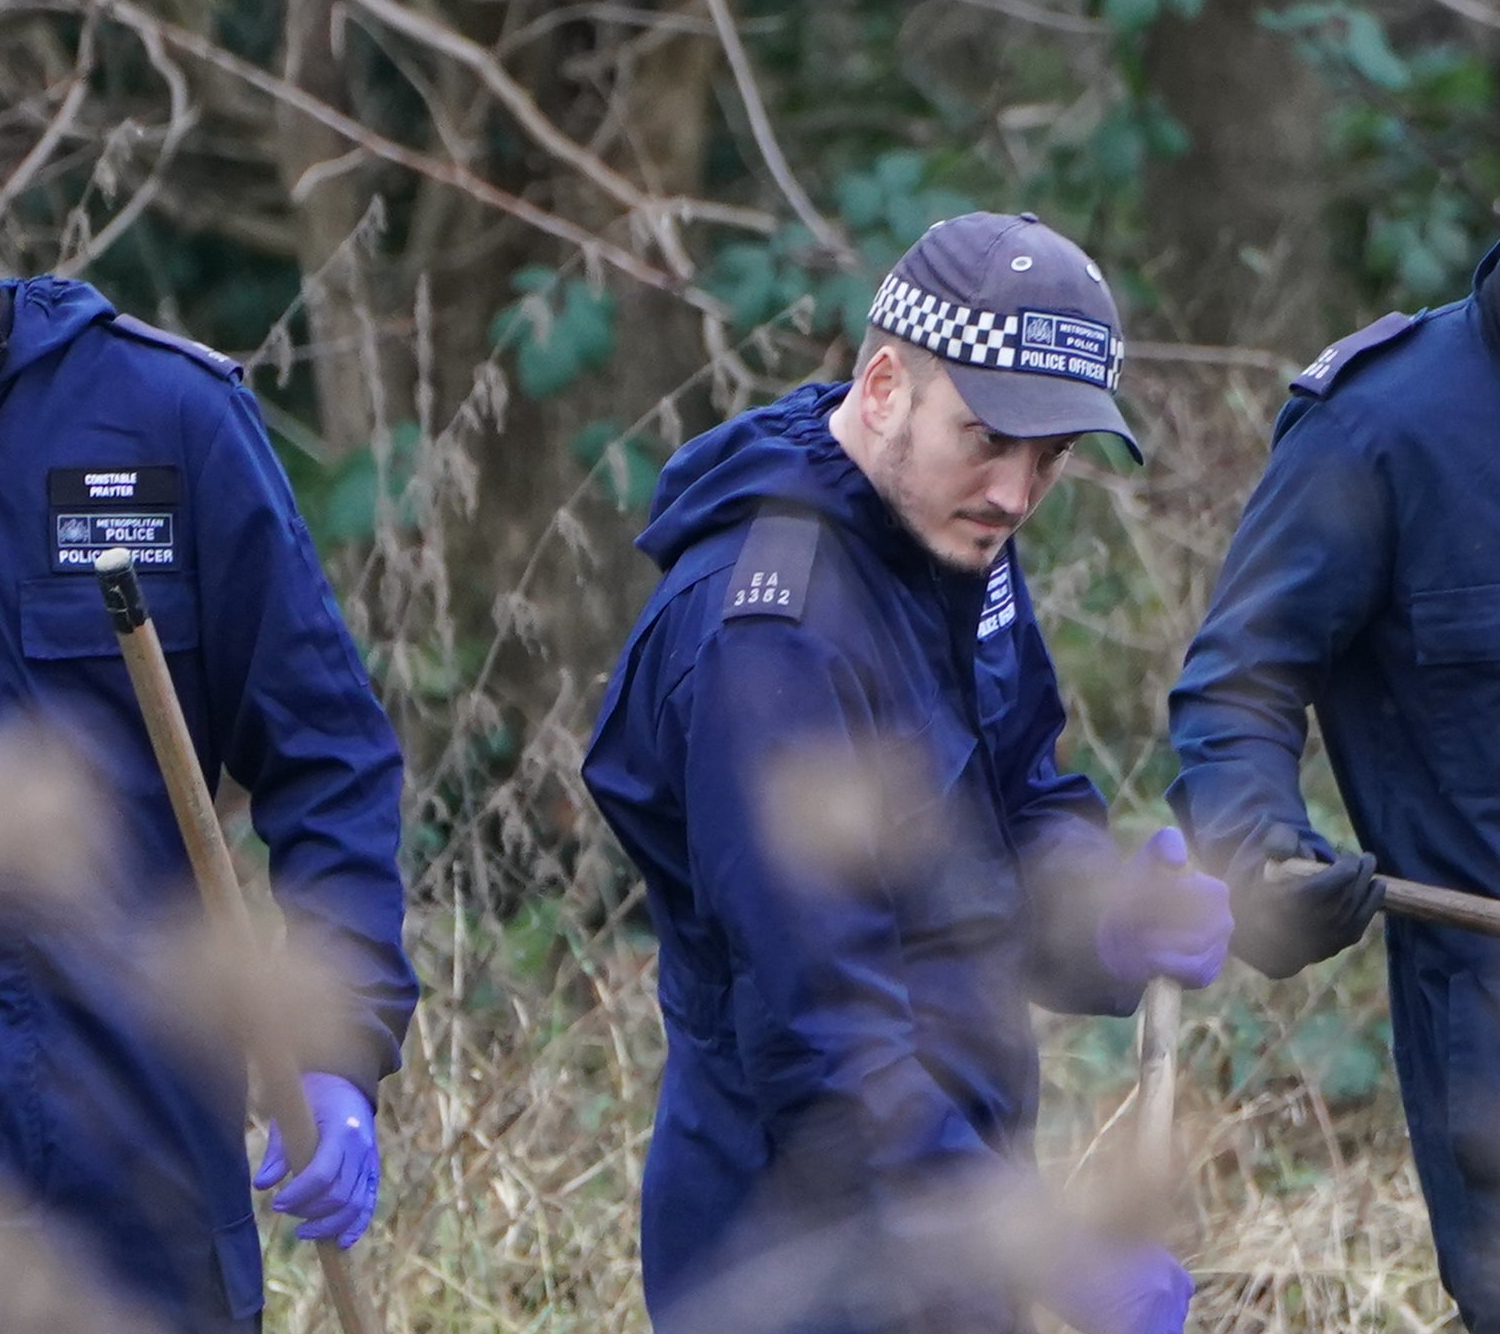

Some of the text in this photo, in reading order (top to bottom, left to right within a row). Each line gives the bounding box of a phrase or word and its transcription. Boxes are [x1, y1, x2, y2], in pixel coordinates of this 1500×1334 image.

[1020, 350, 1106, 381] POLICE OFFICER
[84, 472, 137, 485] CONSTABLE
[96, 518, 164, 528] METROPOLITAN
[105, 528, 155, 542] POLICE
[59, 549, 104, 564] POLIC
[750, 571, 779, 587] EA
